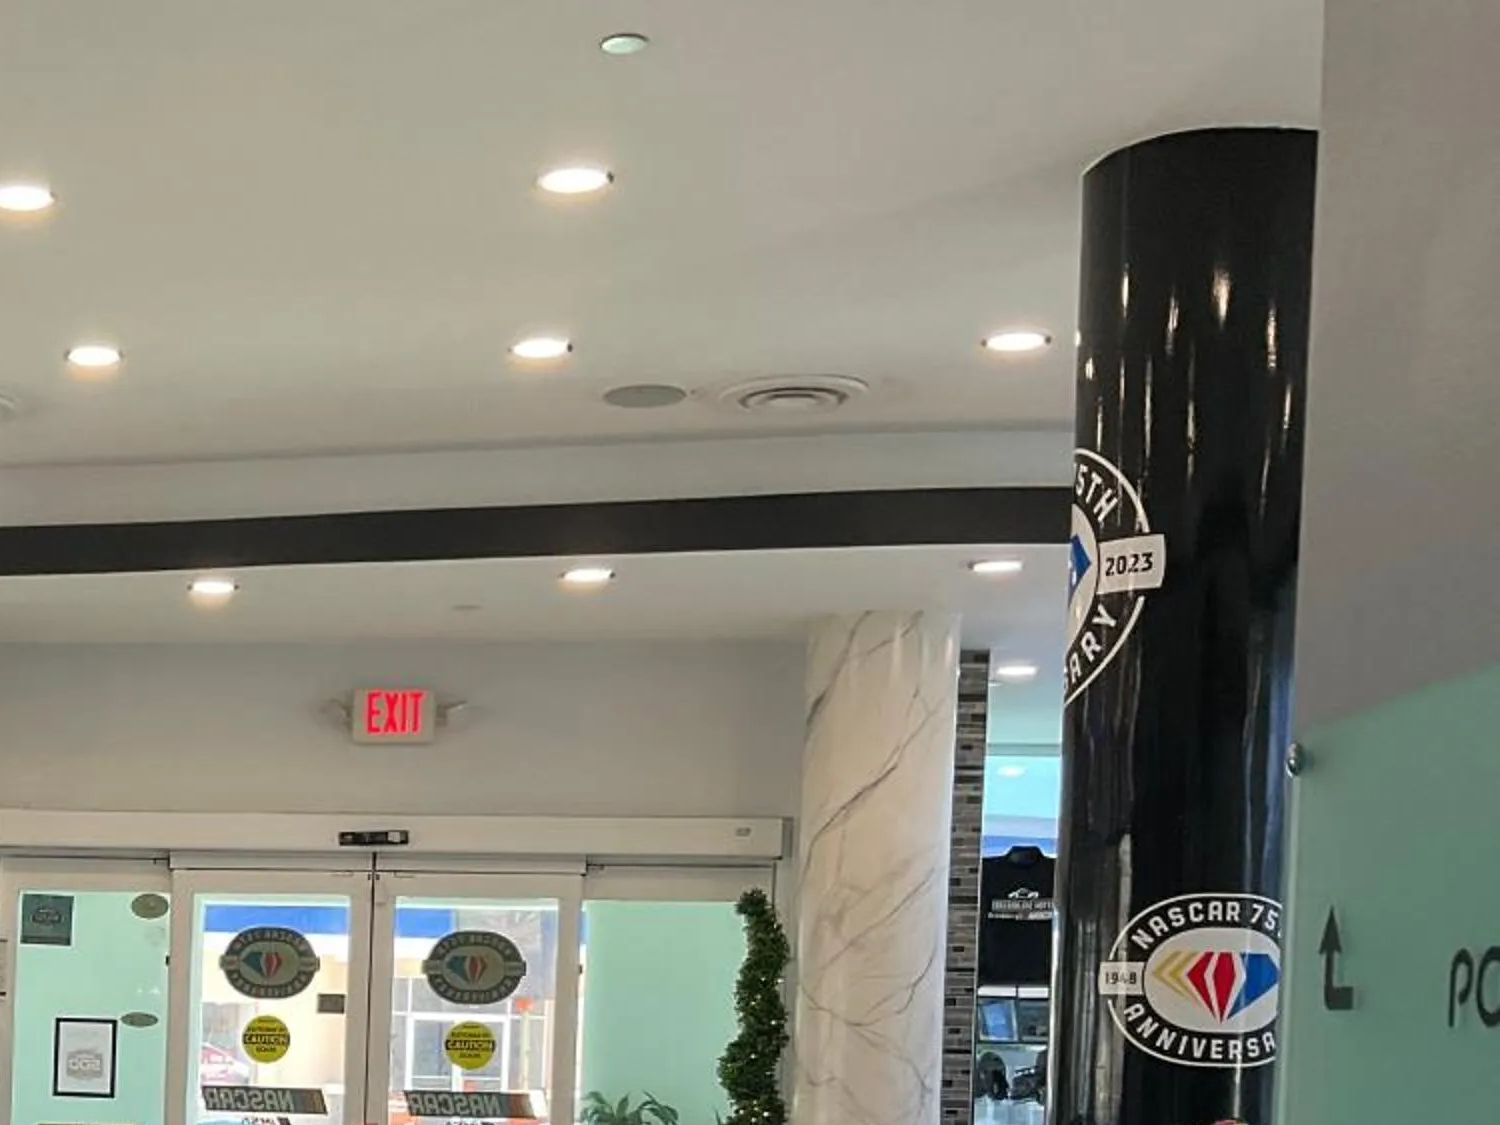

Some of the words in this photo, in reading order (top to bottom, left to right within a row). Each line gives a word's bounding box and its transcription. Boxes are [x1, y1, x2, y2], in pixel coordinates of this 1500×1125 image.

[1074, 463, 1118, 522] 5TH
[1105, 552, 1154, 577] 2023
[366, 691, 424, 735] EXIT
[1130, 901, 1241, 950] NASCAR
[1250, 903, 1282, 938] 75
